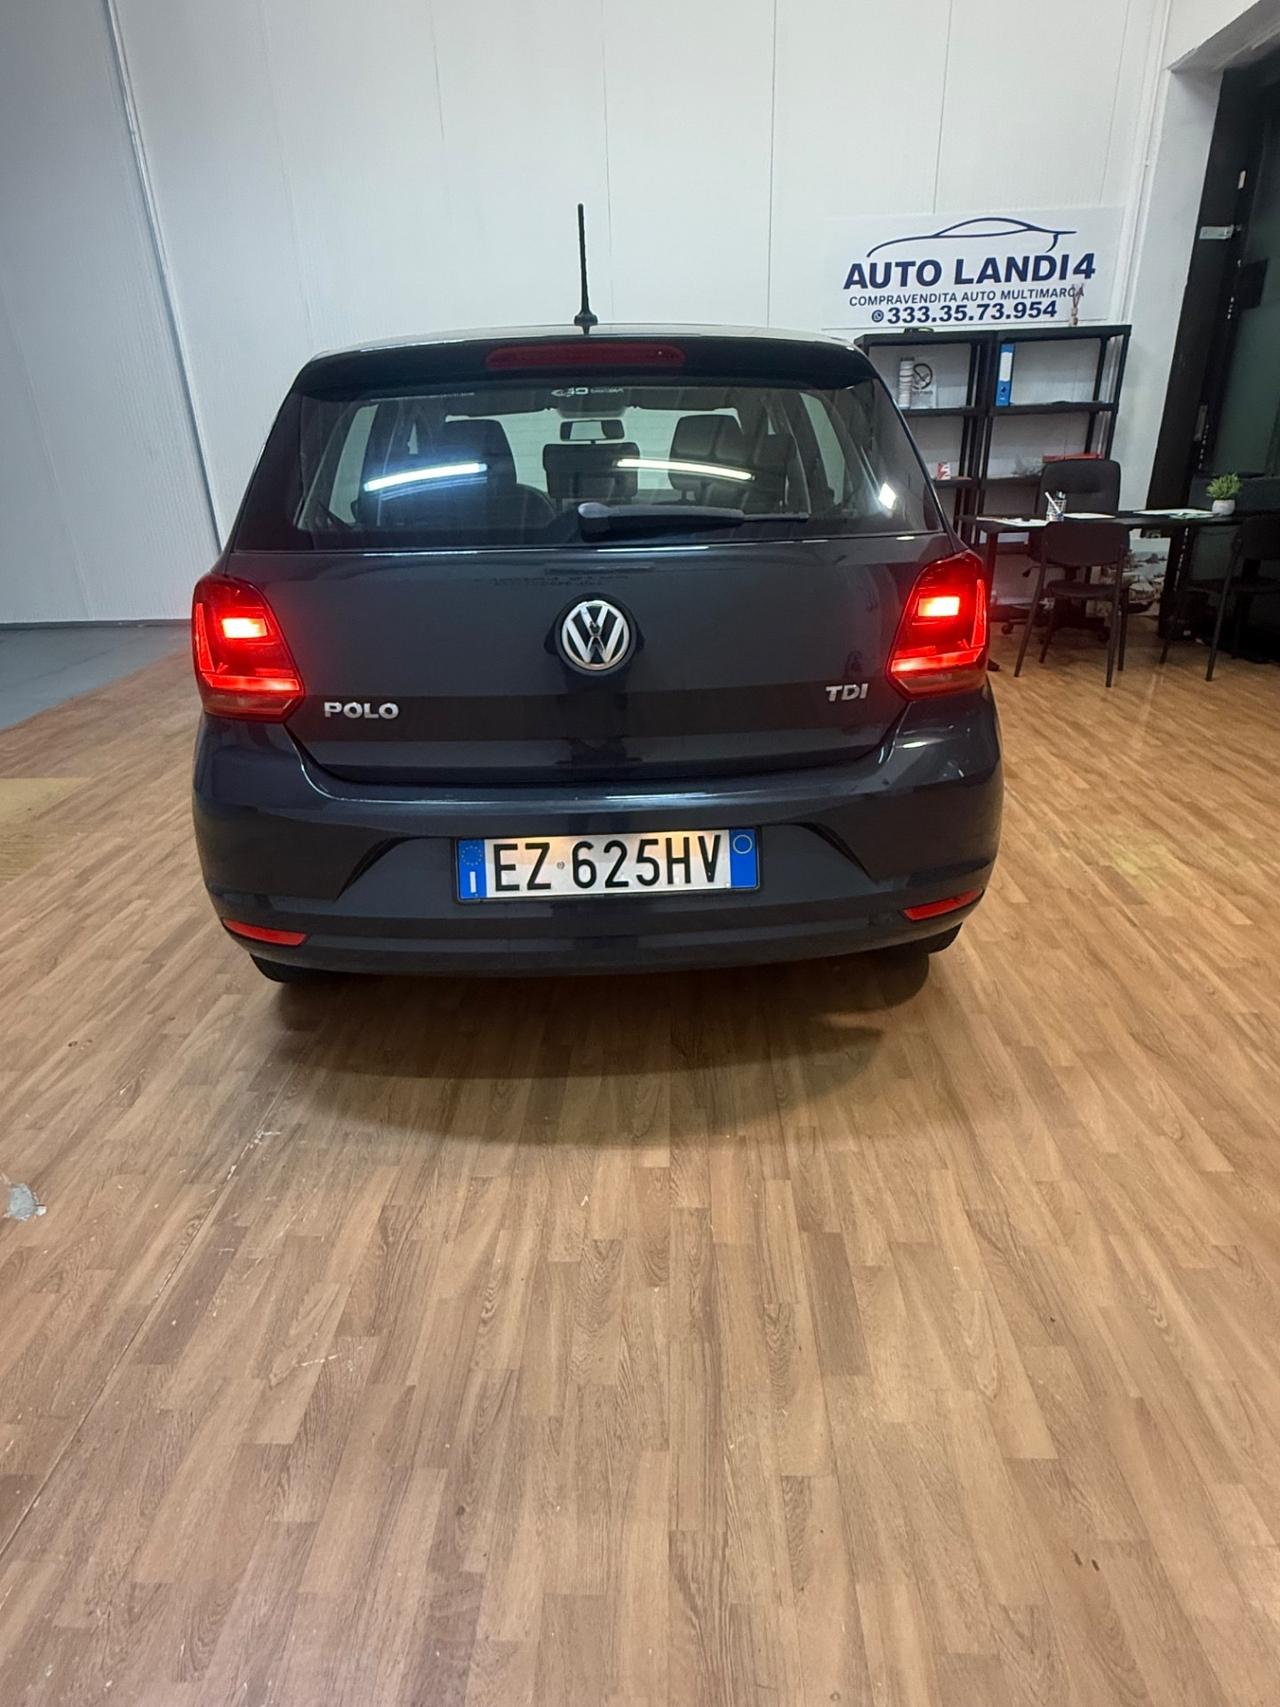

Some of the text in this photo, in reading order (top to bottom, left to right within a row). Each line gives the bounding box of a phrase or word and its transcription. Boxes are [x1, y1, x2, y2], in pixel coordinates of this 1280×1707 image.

[843, 259, 942, 290] AUTO
[850, 286, 1085, 307] COMPRAVENDITA AUTO MULTIMARCA
[887, 300, 1058, 325] 333.35.73.954
[562, 600, 629, 671] VW
[825, 683, 869, 702] TDI
[324, 702, 399, 719] POLO
[493, 834, 722, 892] EZ 625HV
[469, 871, 477, 893] I
